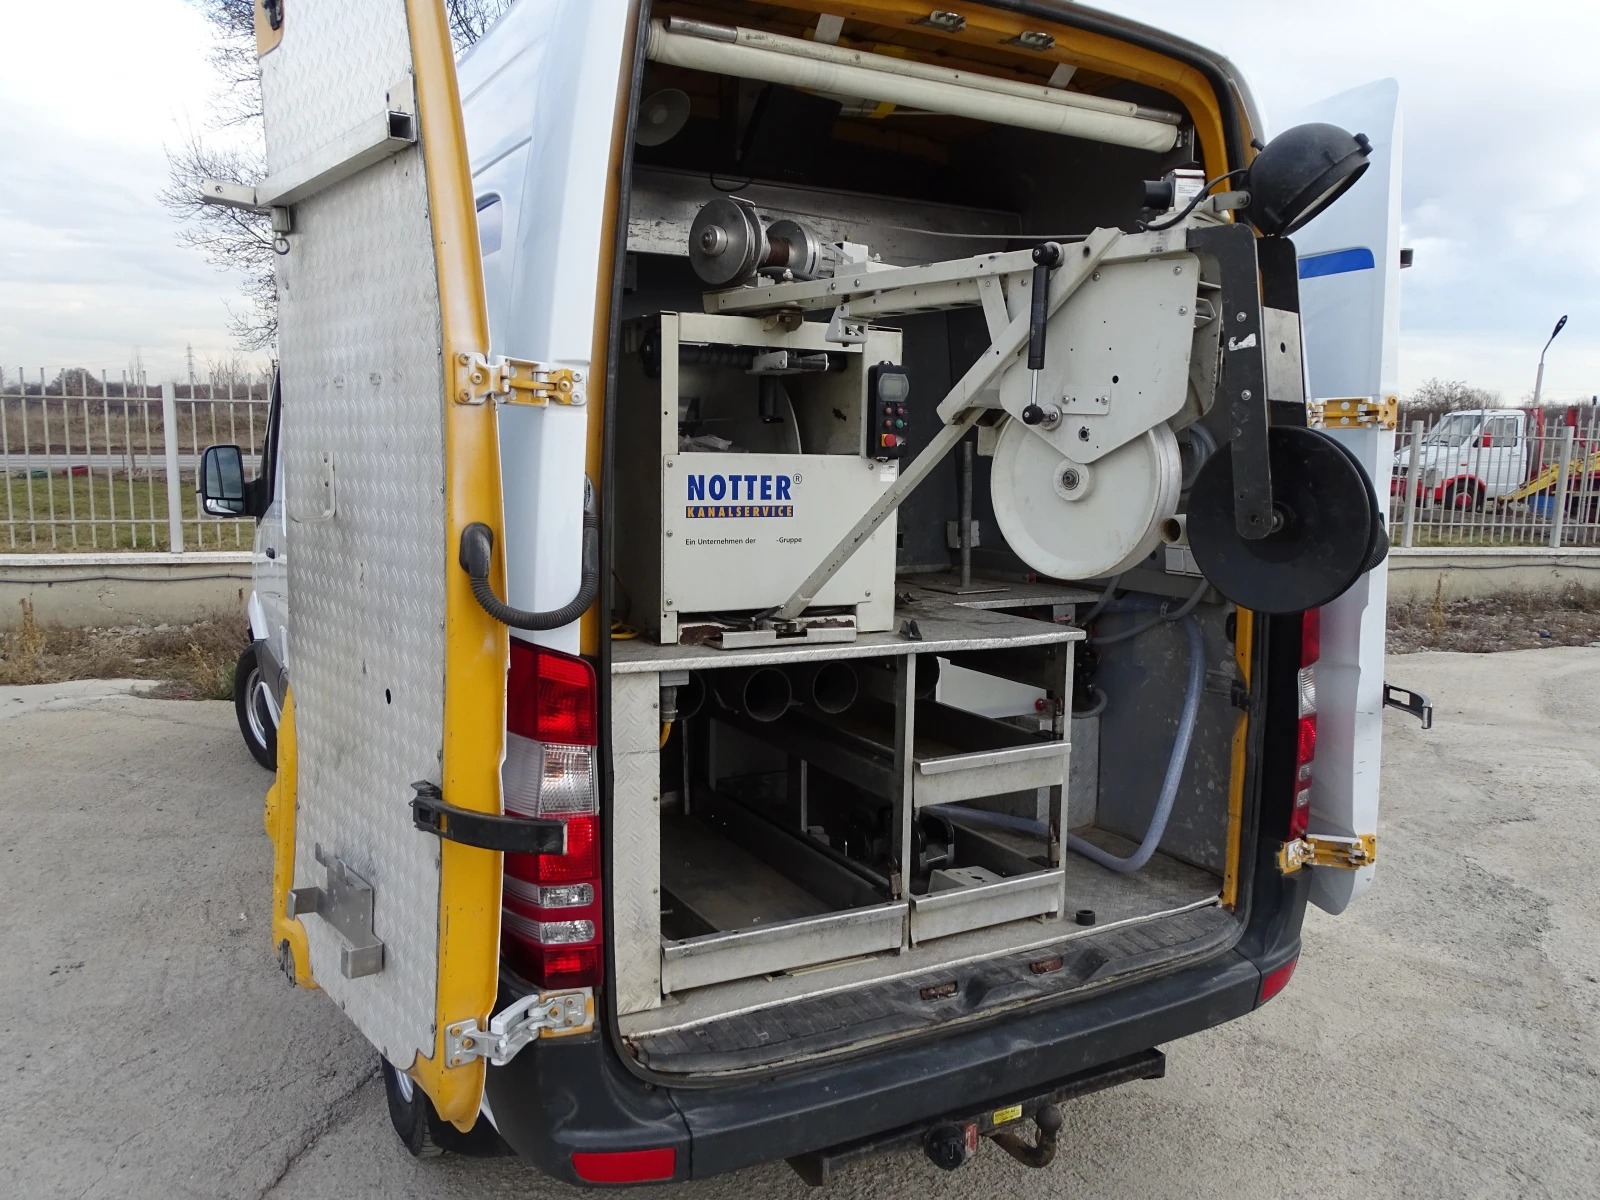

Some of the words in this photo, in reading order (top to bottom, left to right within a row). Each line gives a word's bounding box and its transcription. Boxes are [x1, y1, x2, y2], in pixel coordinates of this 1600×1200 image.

[687, 506, 793, 518] KANALSERVICE
[685, 538, 696, 546] Ein
[697, 537, 744, 546] Unternehmen
[744, 537, 757, 545] der
[775, 536, 803, 545] -Gruppe
